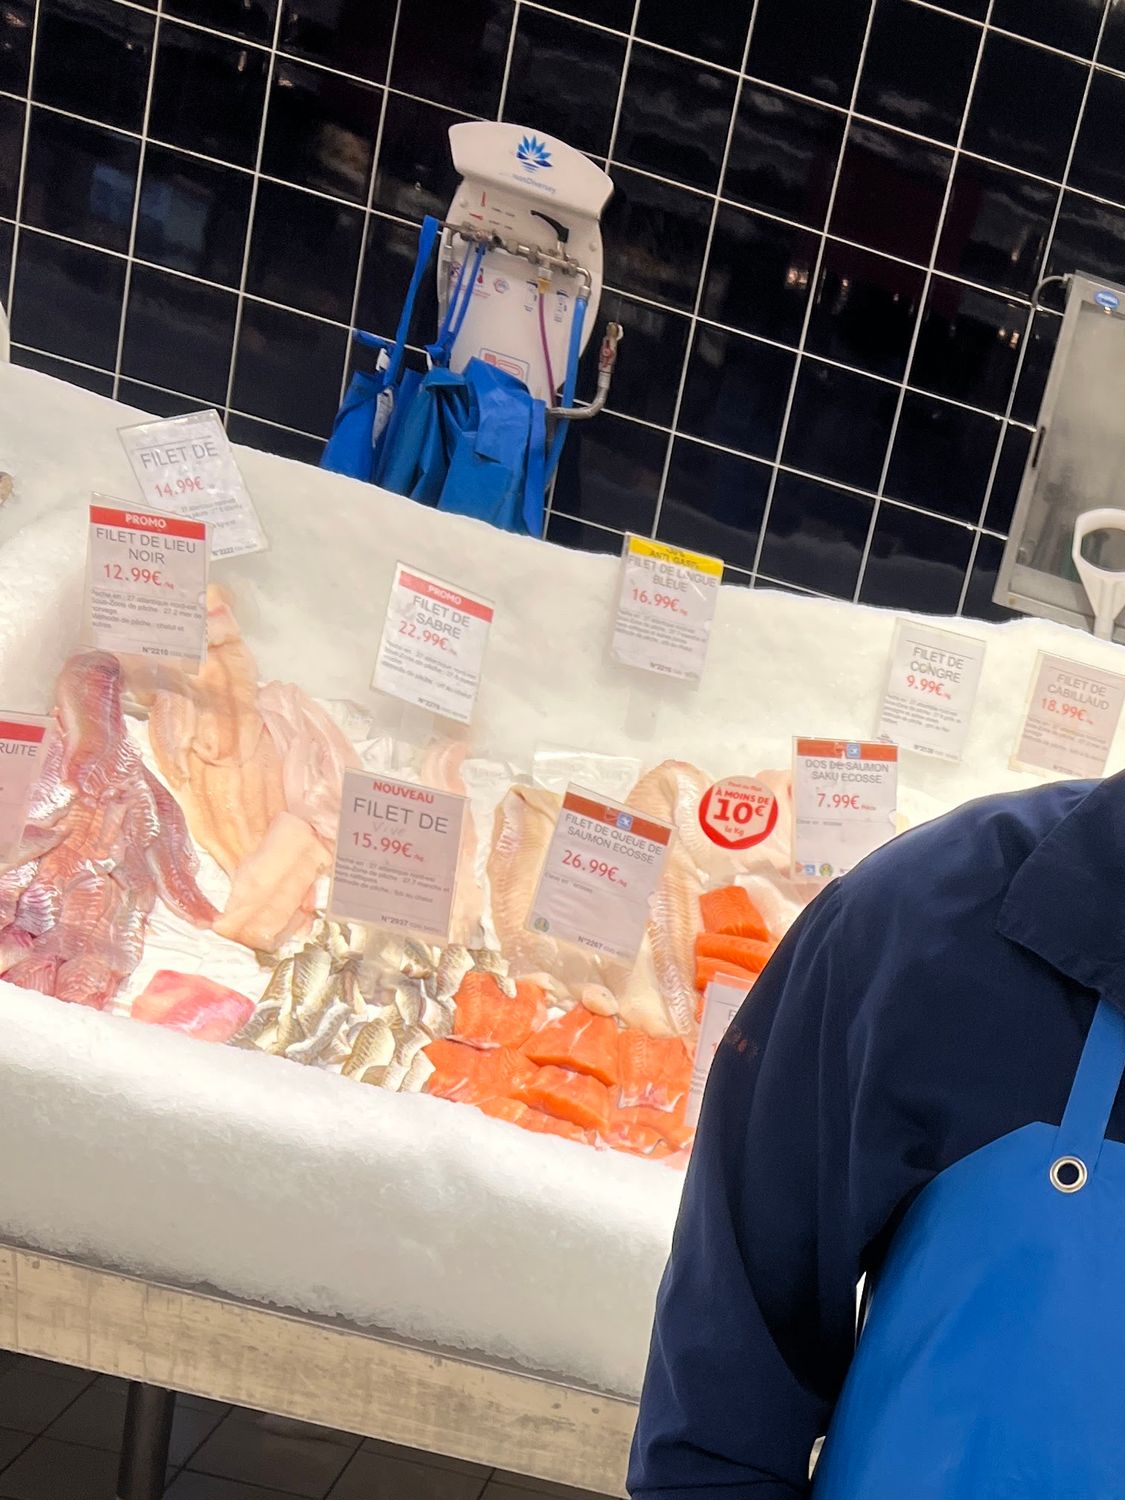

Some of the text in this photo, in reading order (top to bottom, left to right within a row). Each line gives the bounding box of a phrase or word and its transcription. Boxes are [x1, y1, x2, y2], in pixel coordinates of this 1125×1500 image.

[140, 442, 219, 469] FILET DE
[155, 476, 204, 498] 14.99€
[125, 513, 167, 528] PROMO
[96, 528, 196, 554] FILET DE LIEU
[129, 548, 165, 565] NOIR
[104, 564, 162, 586] 12.99€
[660, 563, 675, 575] DE
[653, 575, 689, 592] BLEUE
[632, 588, 680, 611] 16.99€
[413, 595, 470, 628] FILET DE
[399, 621, 449, 650] 22.99€
[416, 613, 461, 640] SABRE
[913, 647, 964, 670] FILET DE
[910, 661, 961, 684] CONGRE
[906, 675, 944, 695] 9.99€
[1057, 674, 1107, 697] FILET DE
[1048, 684, 1110, 711] CABILLAUD
[805, 759, 828, 769] DOS
[845, 761, 889, 773] SAUMON
[811, 771, 882, 784] SAKU ECOSSE
[373, 781, 434, 804] NOUVEAU
[724, 791, 756, 802] MOINS
[757, 794, 769, 805] DE
[817, 793, 860, 810] 7.99€
[354, 797, 449, 834] FILET DE
[352, 832, 413, 858] 15.99€
[565, 813, 662, 855] FILET DE QUEUE DE
[567, 826, 655, 865] SAUMON ECOSSE
[562, 849, 619, 882] 26.99€
